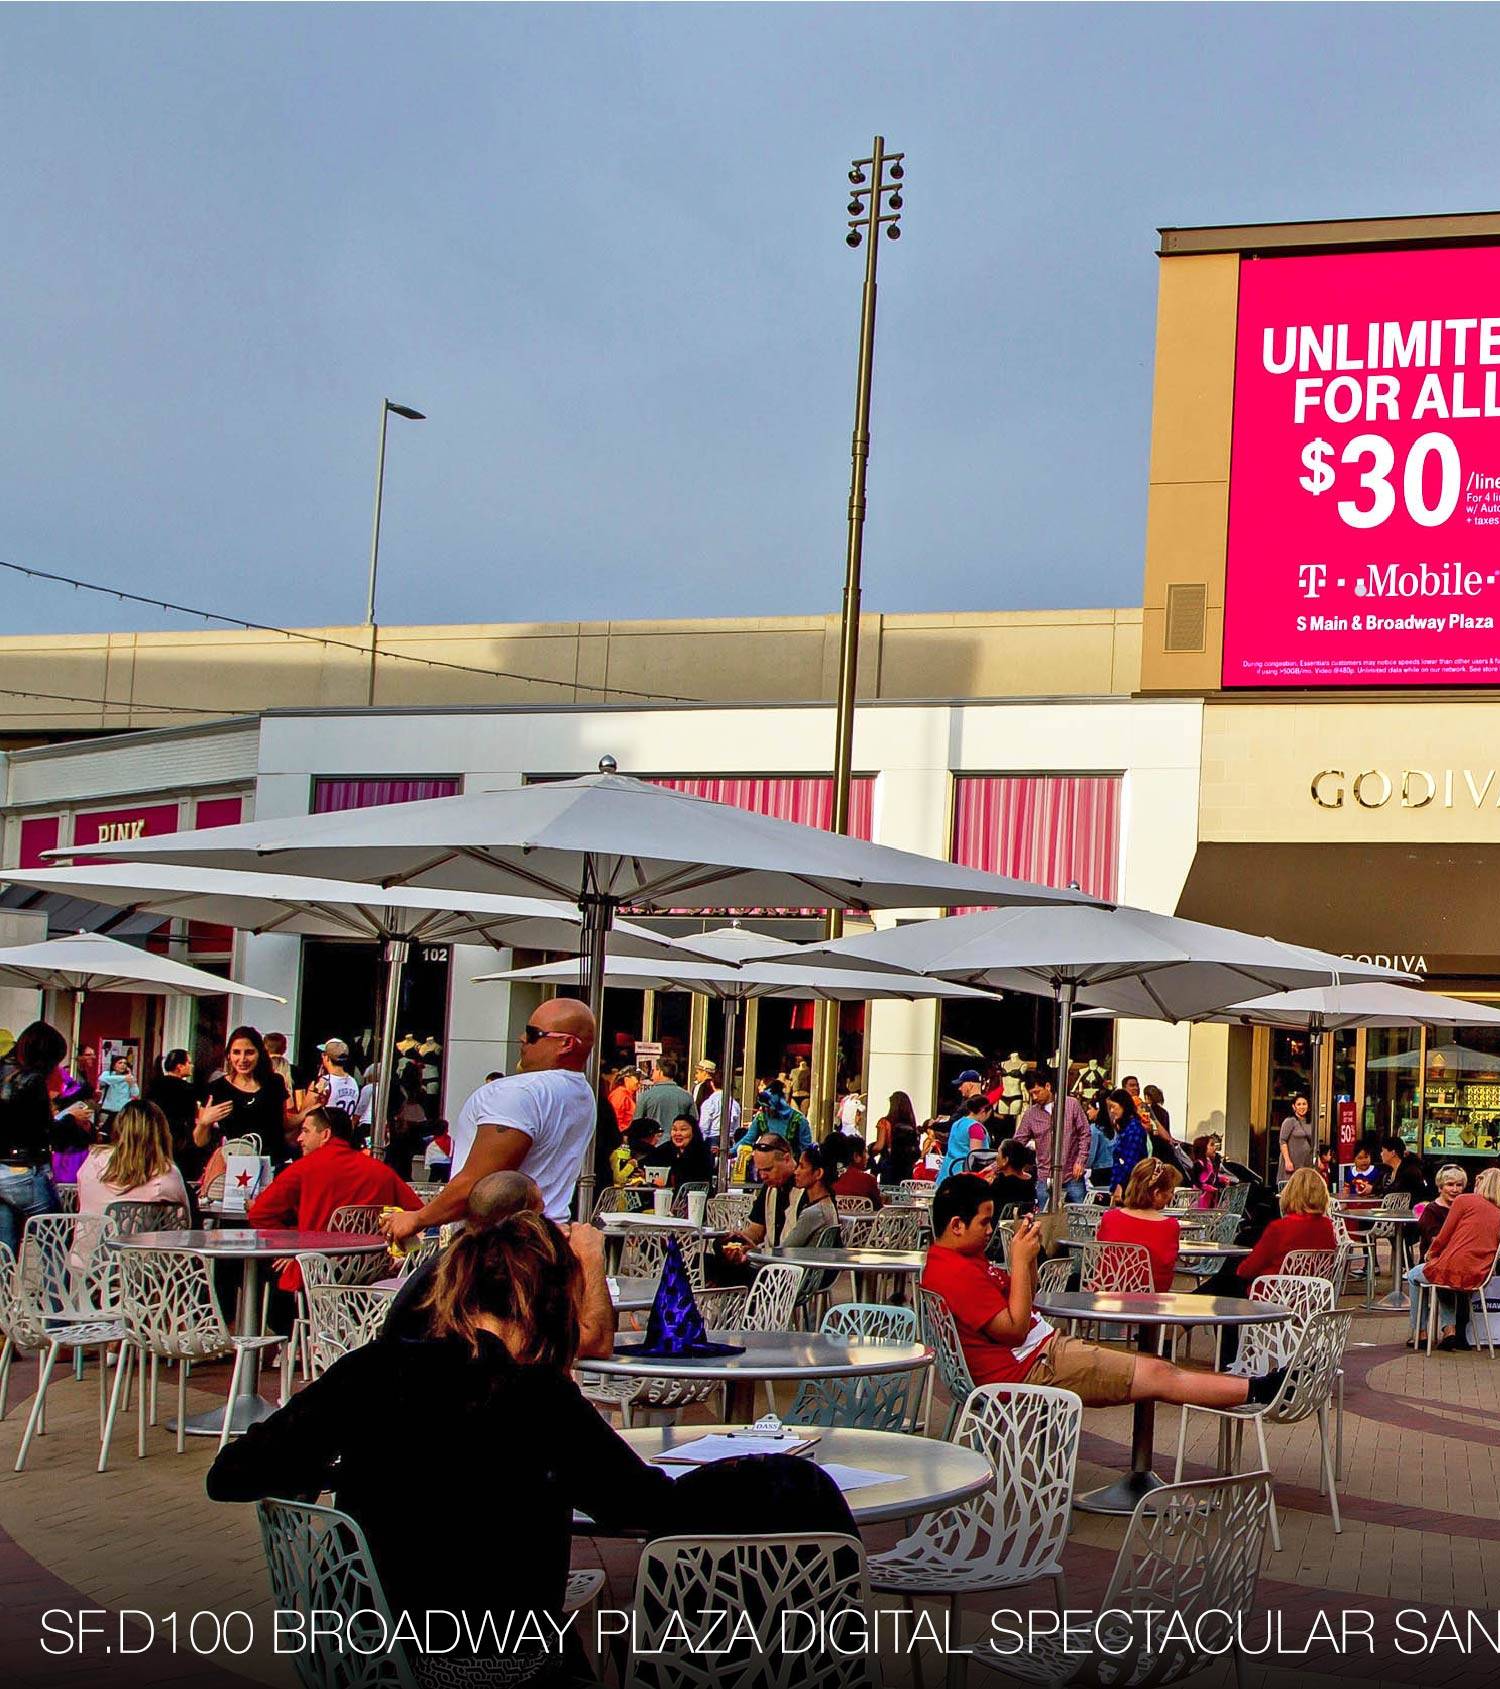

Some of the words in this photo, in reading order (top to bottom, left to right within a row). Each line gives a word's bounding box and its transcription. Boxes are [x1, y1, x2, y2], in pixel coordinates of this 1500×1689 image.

[1294, 374, 1400, 424] FOR
[1299, 432, 1461, 529] $30
[1466, 493, 1482, 502] For
[1485, 493, 1490, 502] 4
[1466, 505, 1478, 514] w/
[1474, 516, 1499, 525] taxes
[1296, 615, 1307, 631] S
[1309, 615, 1348, 631] Main
[1351, 615, 1363, 631] &
[1365, 614, 1446, 633] Broadway
[1449, 613, 1494, 630] Plaza
[98, 818, 146, 844] PINK
[422, 948, 448, 961] 102
